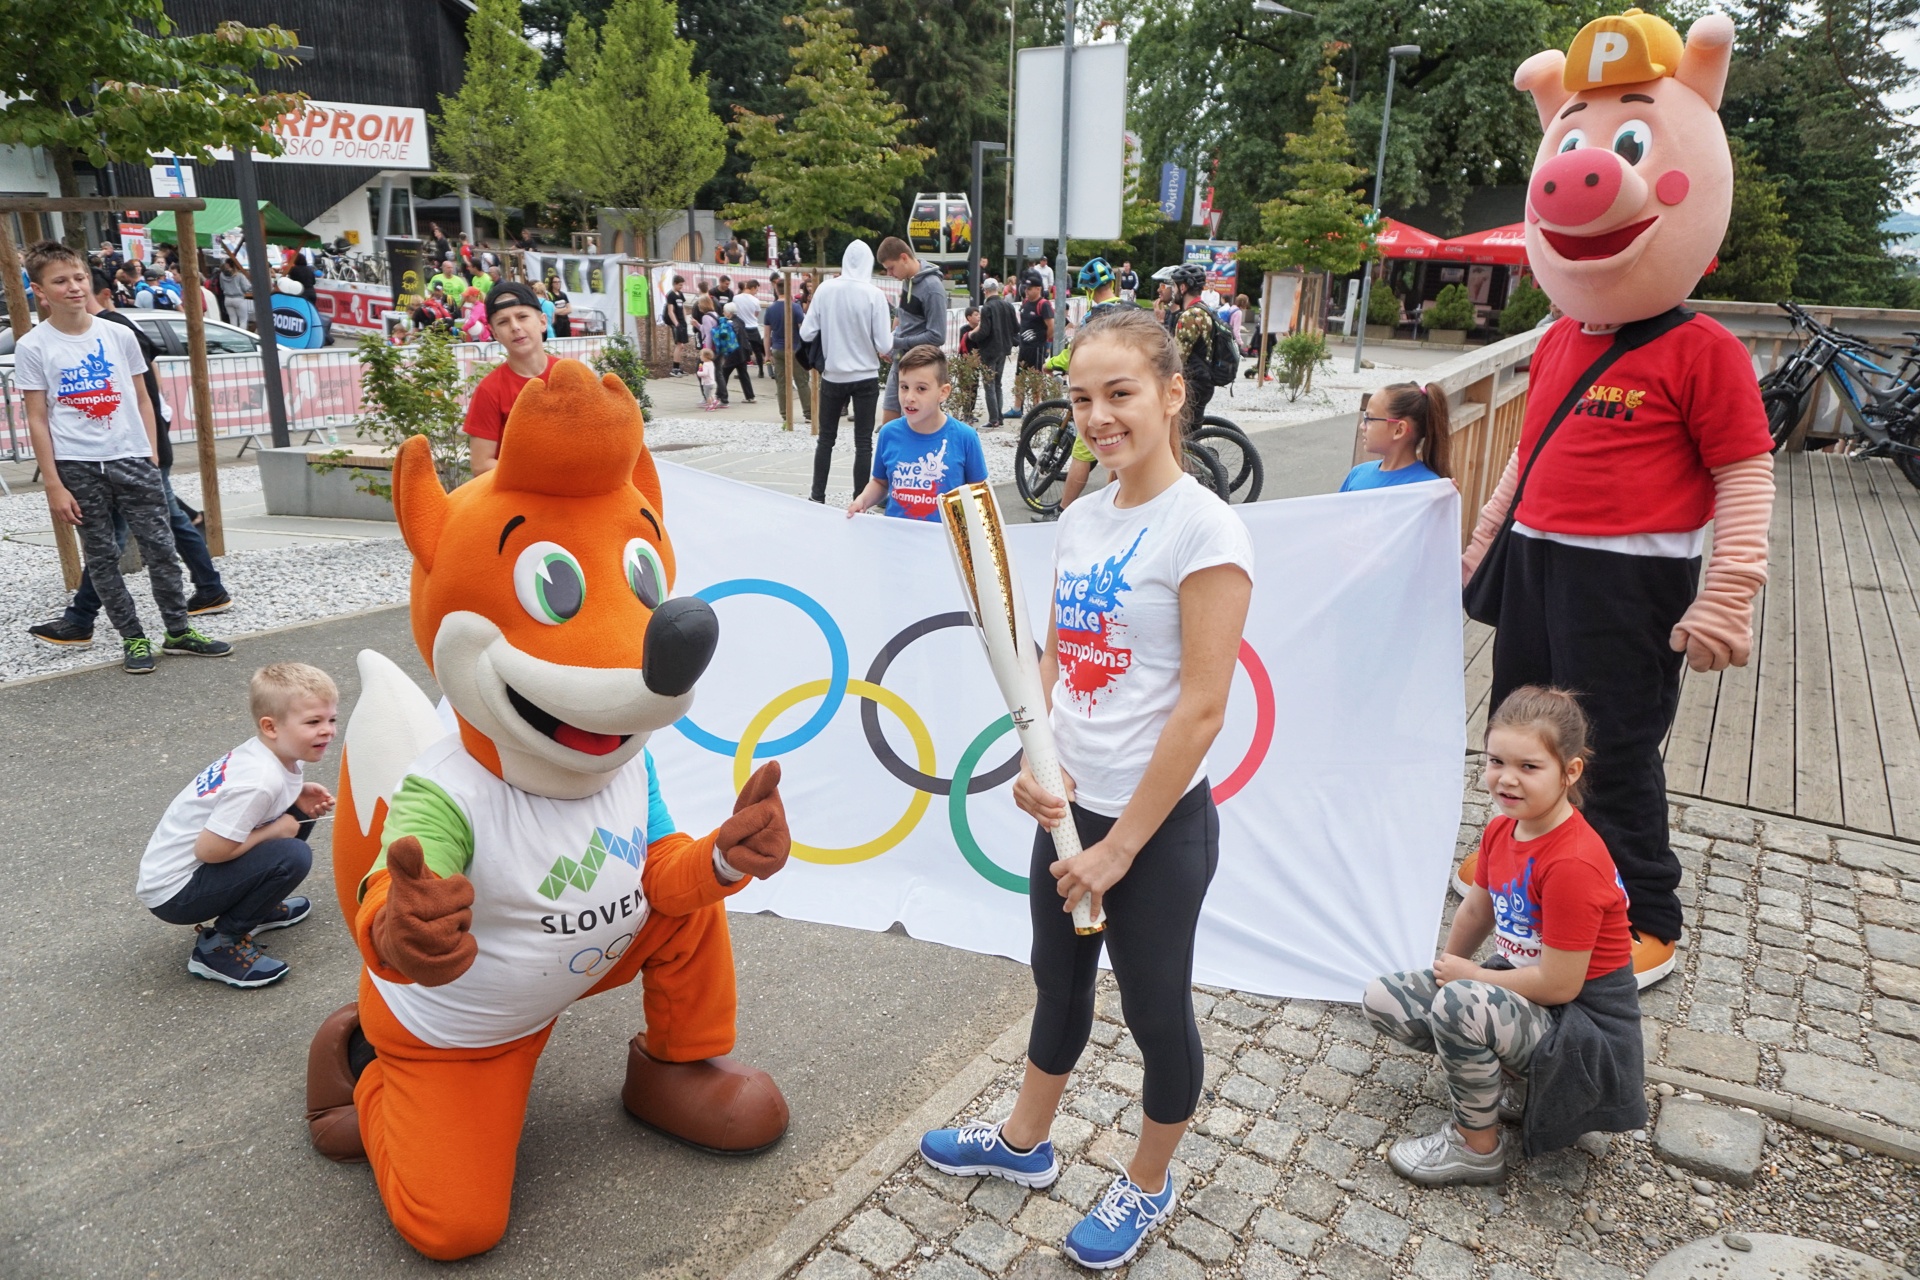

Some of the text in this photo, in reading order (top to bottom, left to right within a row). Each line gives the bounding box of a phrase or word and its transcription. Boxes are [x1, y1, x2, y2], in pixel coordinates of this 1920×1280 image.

[1588, 32, 1629, 82] P
[261, 108, 414, 143] RPROM
[287, 137, 409, 160] SKO POHORJE
[909, 221, 941, 229] WELCOME
[909, 229, 930, 237] HOME
[1187, 252, 1211, 260] CASTLE
[64, 367, 90, 381] we
[60, 378, 105, 394] make
[1586, 385, 1624, 402] SKB
[899, 465, 922, 476] we
[893, 477, 932, 489] make
[891, 490, 940, 505] champion
[1059, 578, 1090, 601] we
[1058, 639, 1131, 668] ampions
[540, 889, 643, 935] SLOVEN
